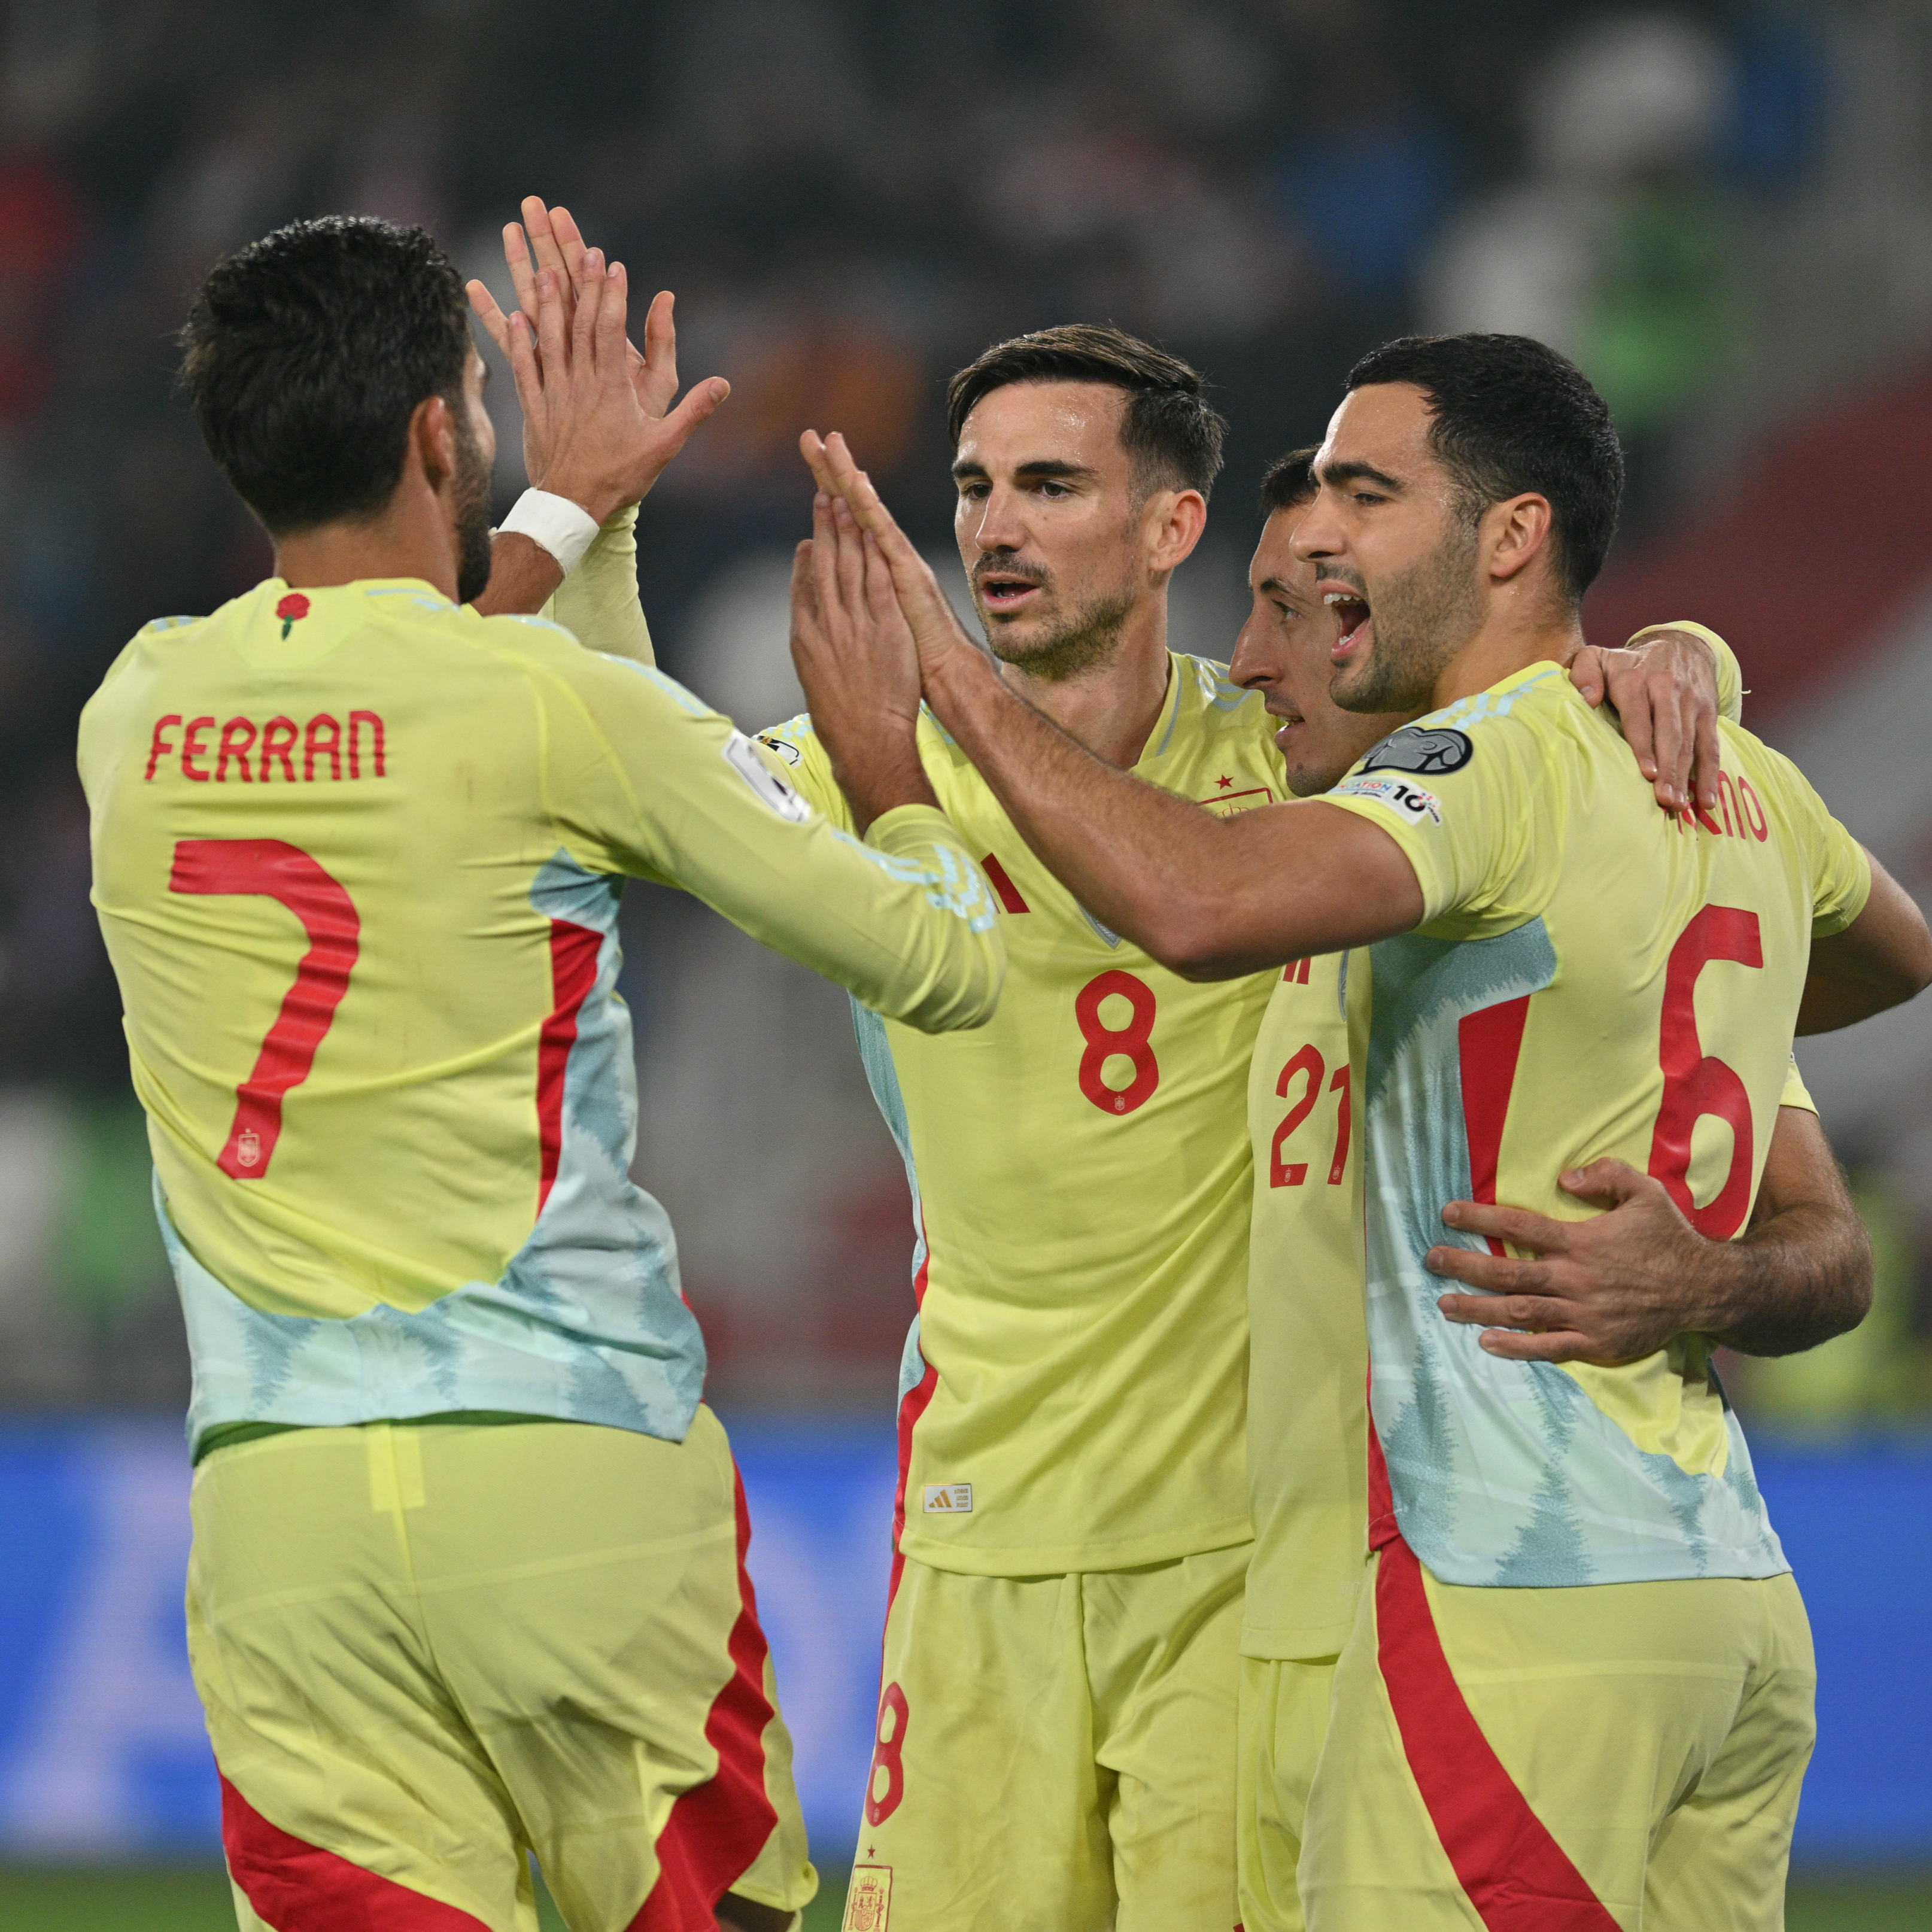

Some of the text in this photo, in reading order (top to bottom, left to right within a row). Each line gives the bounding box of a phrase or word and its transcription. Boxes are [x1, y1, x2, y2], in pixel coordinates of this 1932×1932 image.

[144, 710, 386, 783] FERRAN
[1393, 785, 1426, 812] 10
[169, 839, 361, 1180] 7
[1075, 969, 1159, 1116] 8
[1648, 903, 1764, 1242] 6
[1270, 1043, 1351, 1189] 21
[865, 1681, 909, 1827] 8
